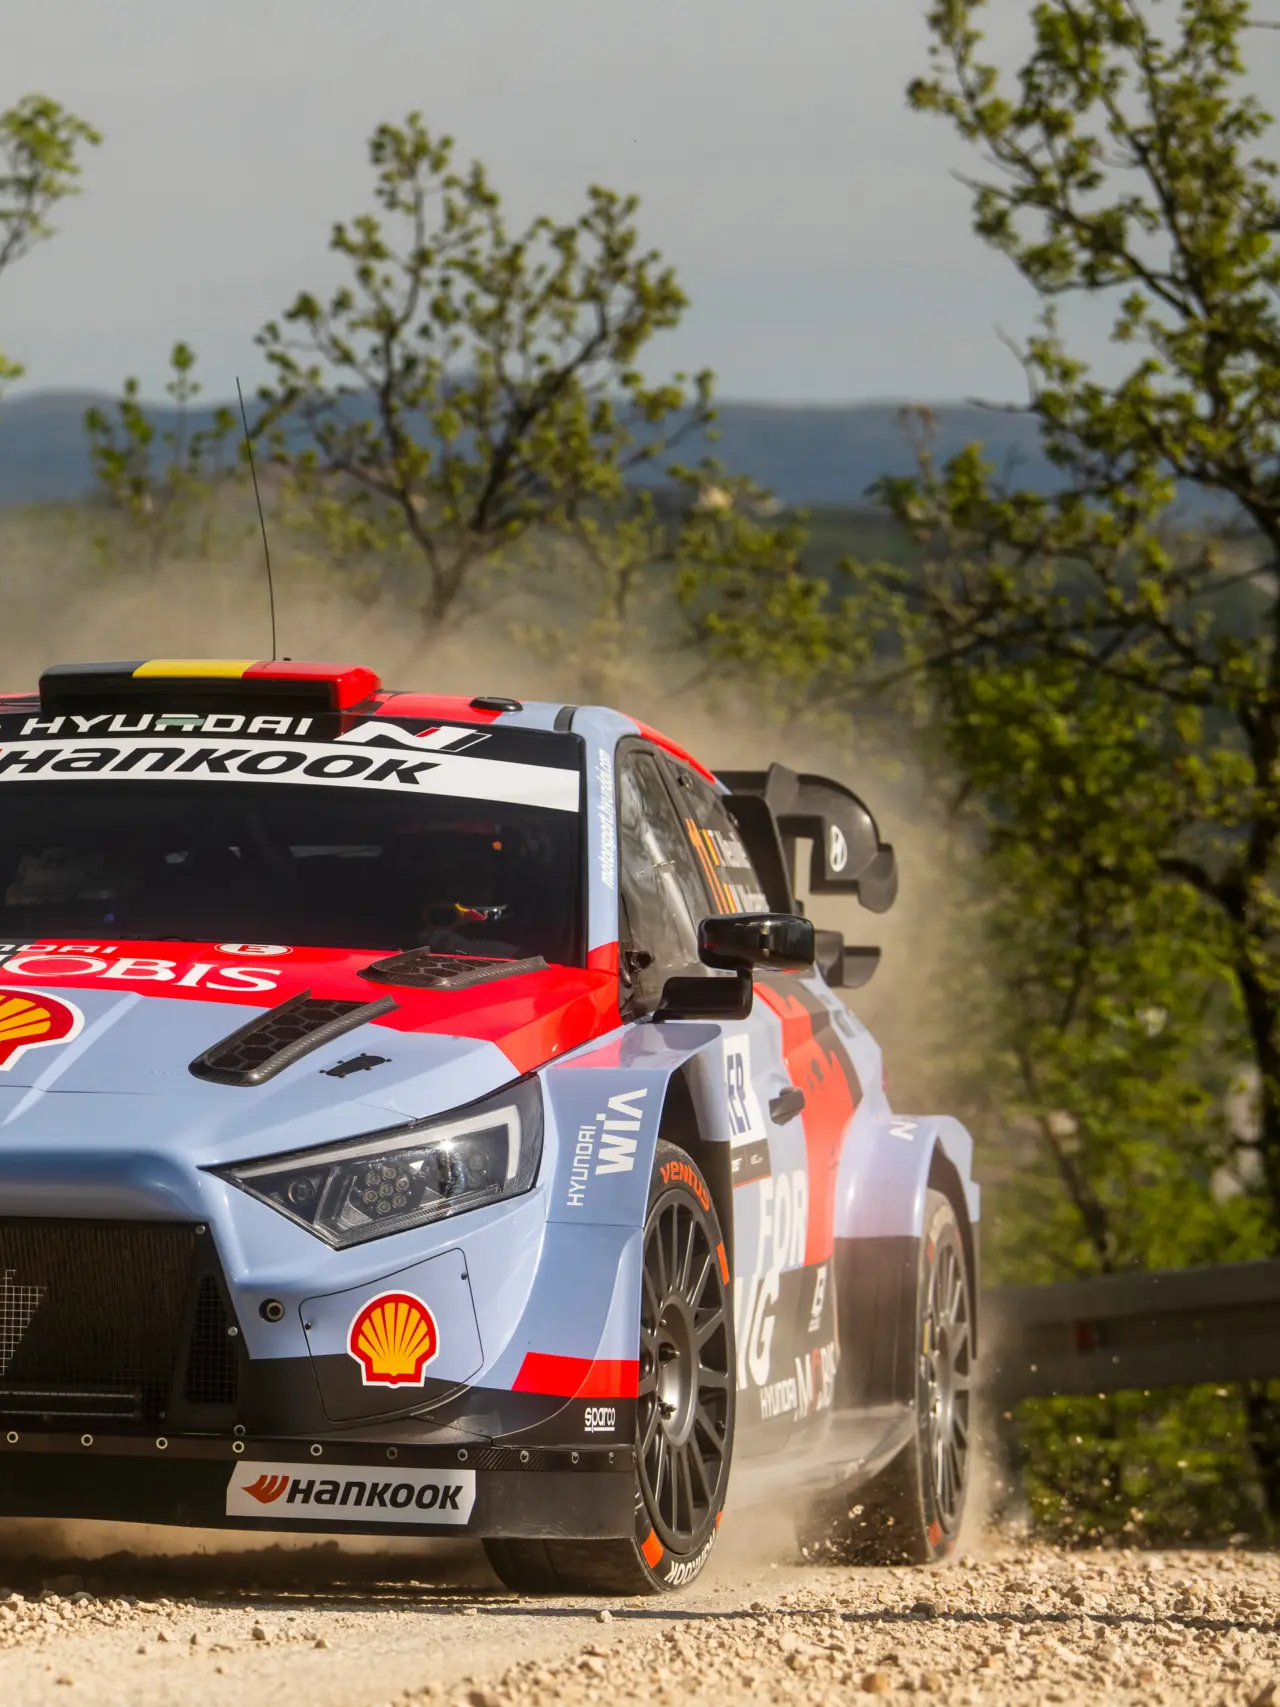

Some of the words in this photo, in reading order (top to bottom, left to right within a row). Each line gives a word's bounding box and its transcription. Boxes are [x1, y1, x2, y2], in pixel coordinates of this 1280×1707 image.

[21, 714, 312, 736] HYUNDAI
[599, 748, 616, 889] motorsport.hyundai.com
[567, 1125, 596, 1206] HYUNDAI
[584, 1407, 616, 1433] sparco
